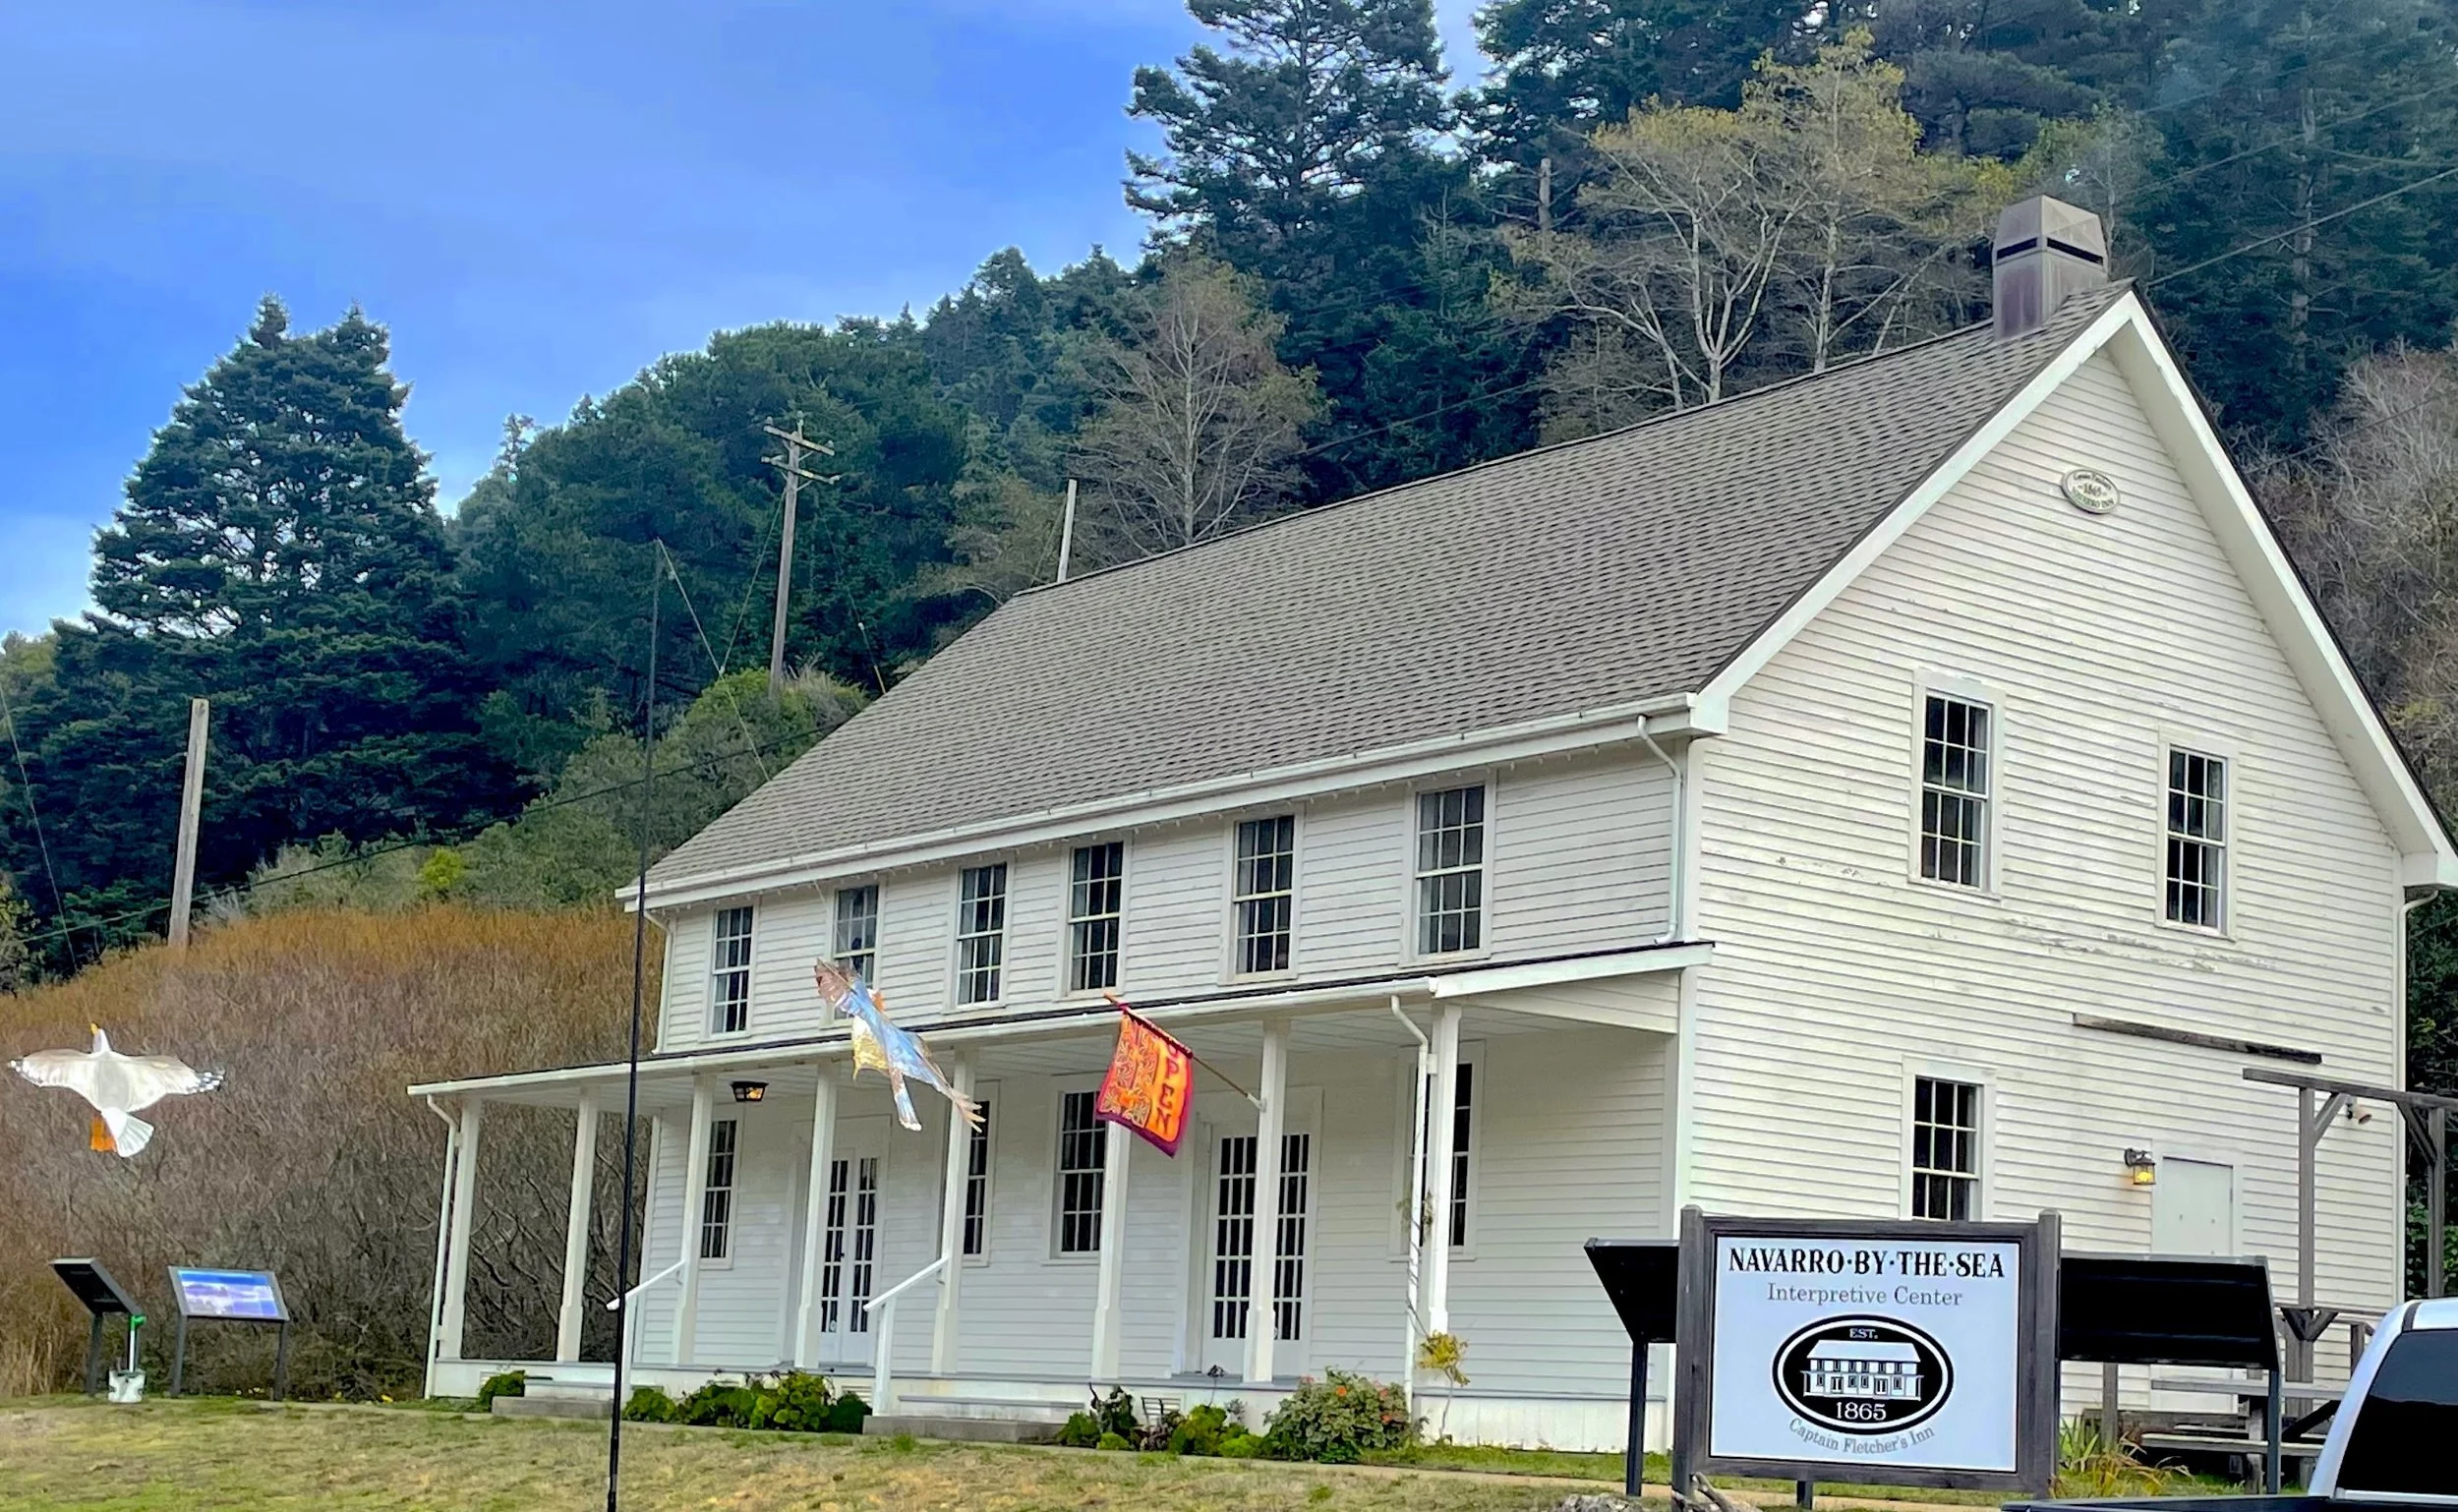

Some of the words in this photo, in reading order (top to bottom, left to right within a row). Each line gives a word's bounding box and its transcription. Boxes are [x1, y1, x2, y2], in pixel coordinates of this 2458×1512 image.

[1767, 1281, 1888, 1307] Interpretive
[1894, 1285, 1963, 1307] Center
[1849, 1327, 1879, 1339] EST.
[1836, 1401, 1887, 1422] 1865
[1788, 1417, 1840, 1452] Captain
[1843, 1434, 1909, 1455] Fletcher's
[1908, 1425, 1936, 1446] Inn
